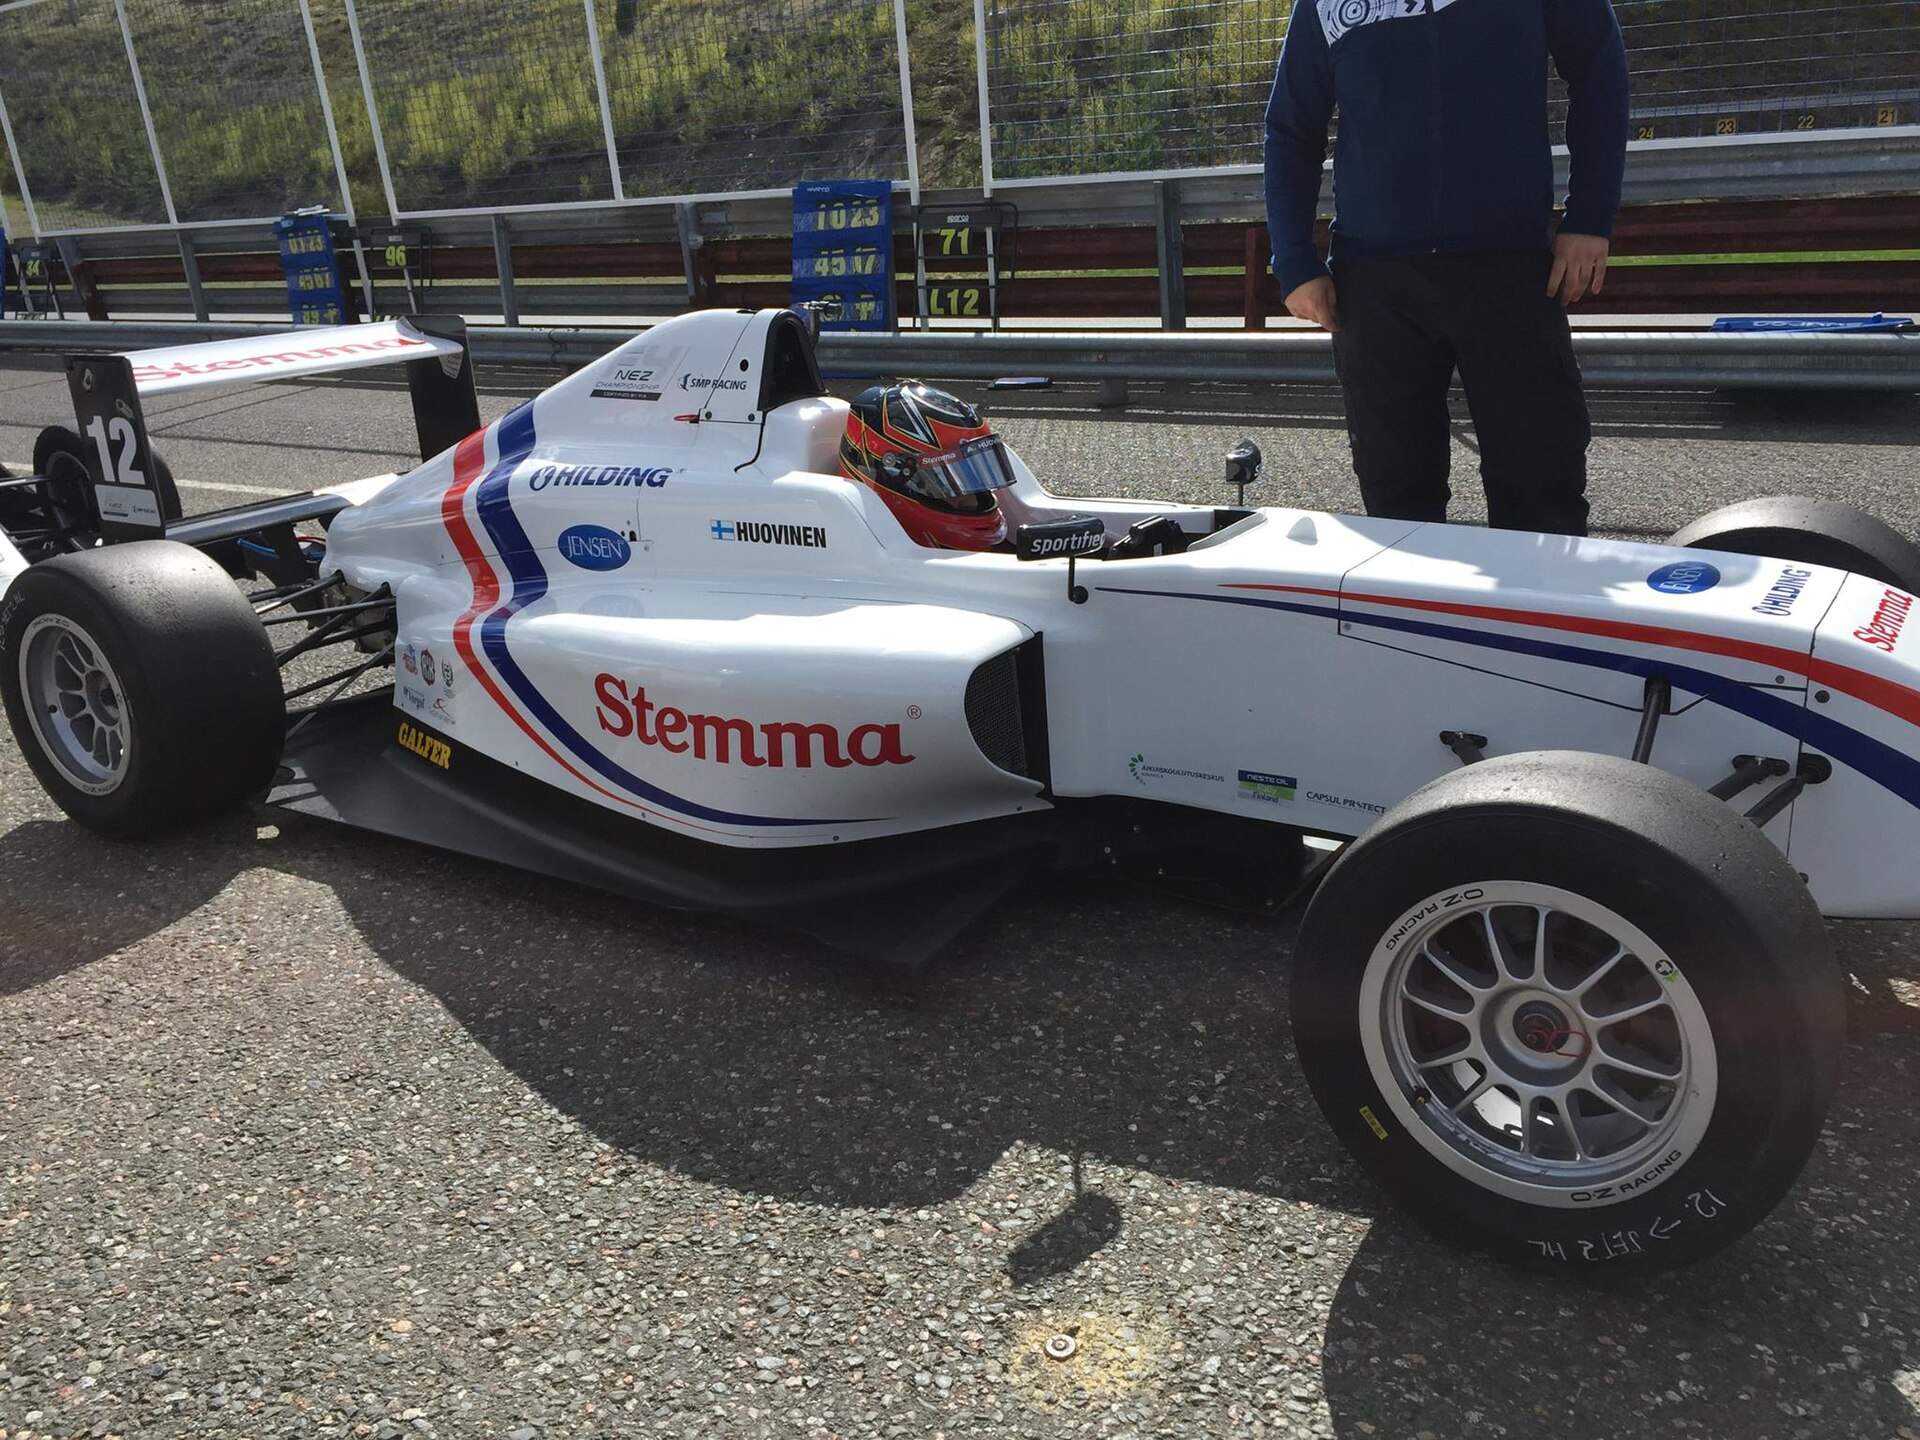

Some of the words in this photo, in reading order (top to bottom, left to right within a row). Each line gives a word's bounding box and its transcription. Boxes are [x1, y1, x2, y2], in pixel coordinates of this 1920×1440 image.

[1718, 120, 1735, 134] 23
[1797, 114, 1815, 129] 22
[1879, 109, 1896, 124] 21
[1639, 127, 1654, 140] 24
[939, 227, 970, 255] 71
[385, 245, 407, 267] 96
[25, 260, 41, 276] 34
[930, 288, 980, 316] L12
[132, 337, 426, 383] Stemma
[595, 380, 661, 391] CHAMPIONSHIP
[614, 368, 655, 382] NEZ
[690, 378, 711, 388] SMP
[711, 379, 748, 391] RACING
[85, 414, 146, 486] 12
[921, 452, 956, 465] Stemma
[553, 465, 674, 488] HILDING
[735, 521, 828, 549] HUOVINEN
[566, 535, 622, 560] JENSEN
[1760, 568, 1813, 609] HILDING
[1852, 588, 1914, 653] Stemma
[593, 672, 917, 769] Stemma
[398, 721, 452, 771] GALFER
[1141, 765, 1225, 782] AIKUISKOULUTUSKESKUS
[1252, 791, 1280, 804] Finland
[1306, 791, 1341, 806] CAPSUL
[1385, 902, 1439, 951] RACING
[1618, 1149, 1683, 1194] RACING
